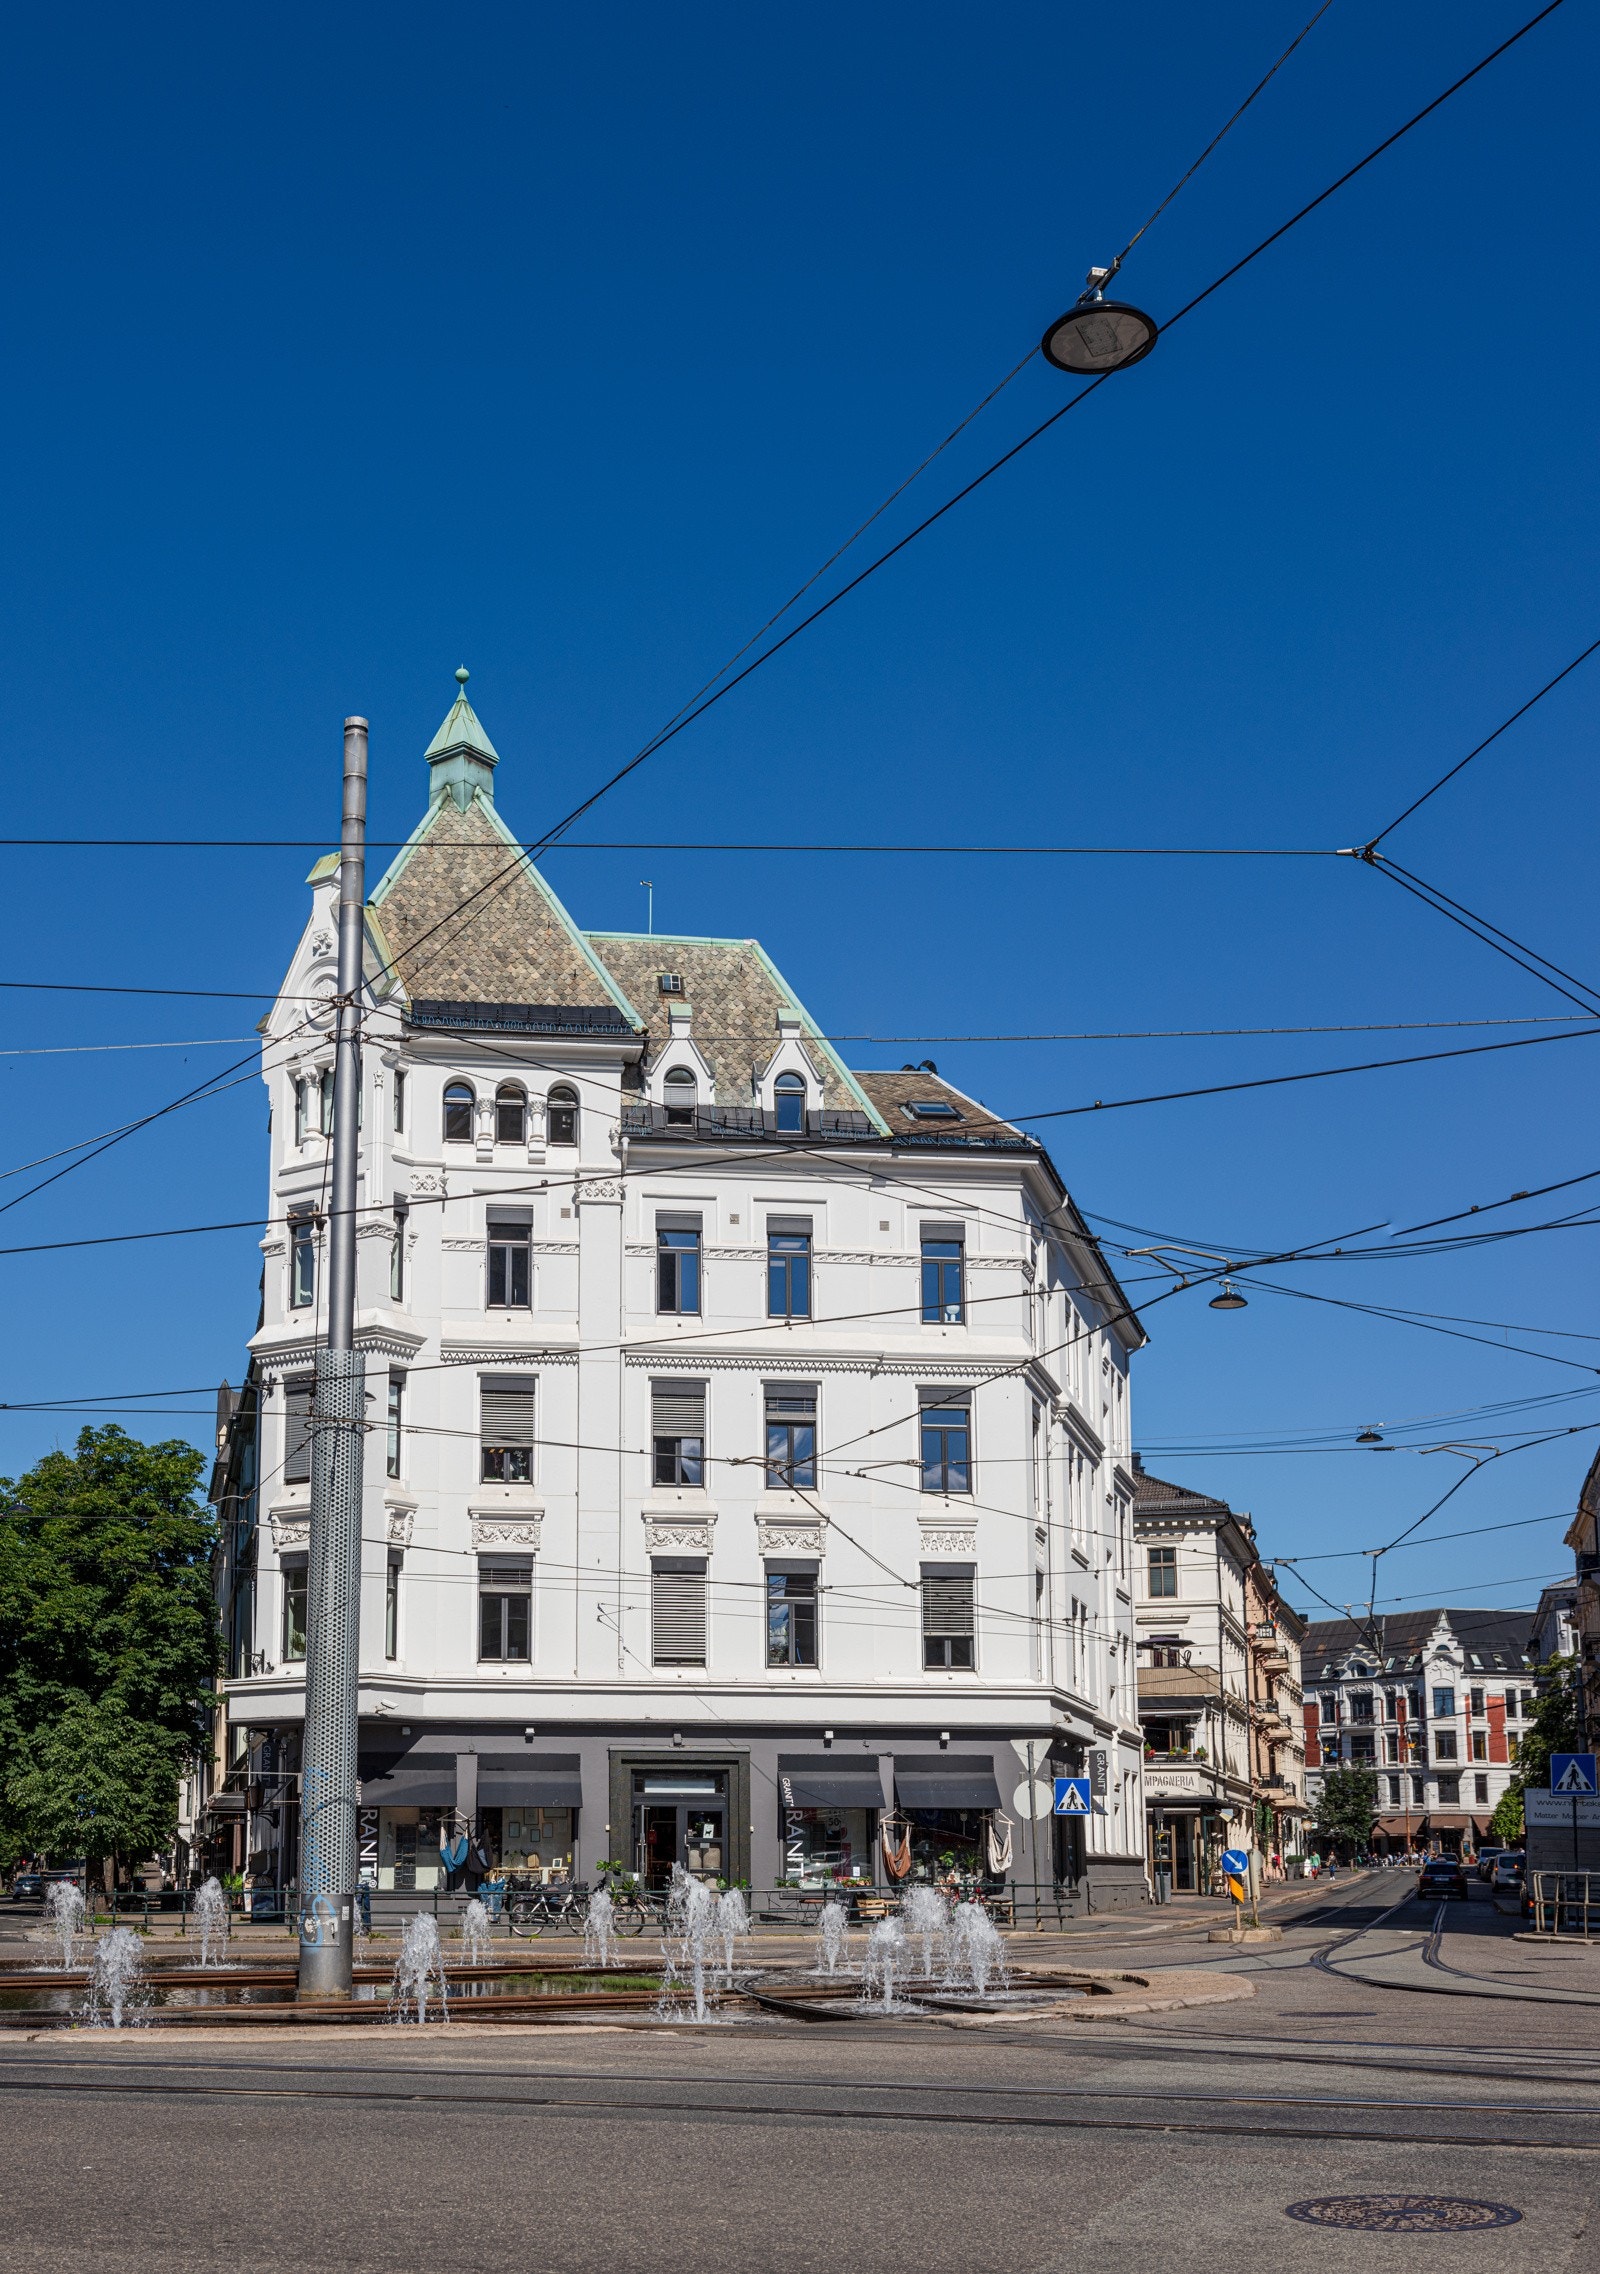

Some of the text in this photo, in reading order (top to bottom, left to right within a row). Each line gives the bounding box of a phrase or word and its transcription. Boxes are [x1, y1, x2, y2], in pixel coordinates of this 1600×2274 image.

[262, 1745, 272, 1782] GRANT
[1096, 1752, 1106, 1790] GRANIT
[782, 1777, 794, 1804] GRANIT
[1562, 1812, 1589, 1820] Moper
[360, 1807, 378, 1878] RANIT
[786, 1808, 804, 1878] RANIT
